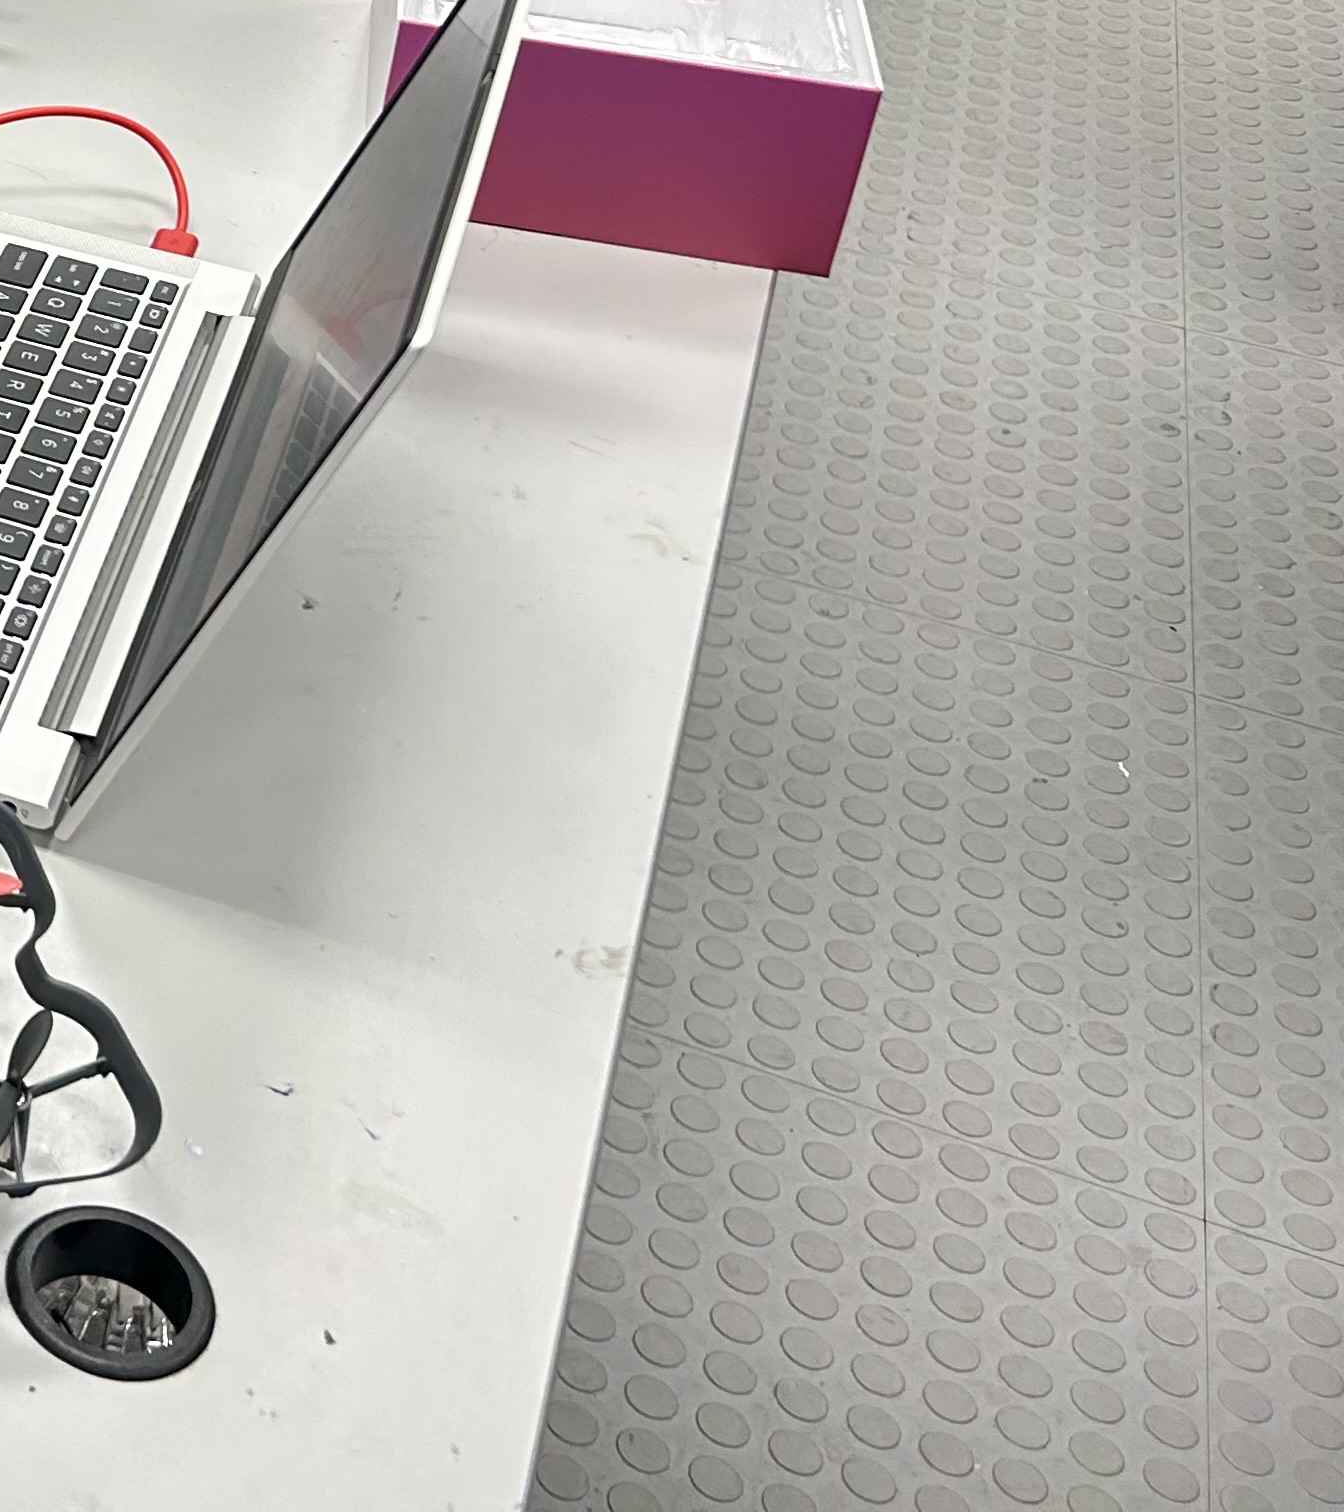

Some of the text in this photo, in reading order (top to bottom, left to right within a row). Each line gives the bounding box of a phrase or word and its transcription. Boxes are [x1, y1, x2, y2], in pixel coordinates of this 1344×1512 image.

[47, 297, 65, 309] Q
[34, 323, 54, 337] W
[20, 351, 39, 362] E
[6, 378, 26, 390] R
